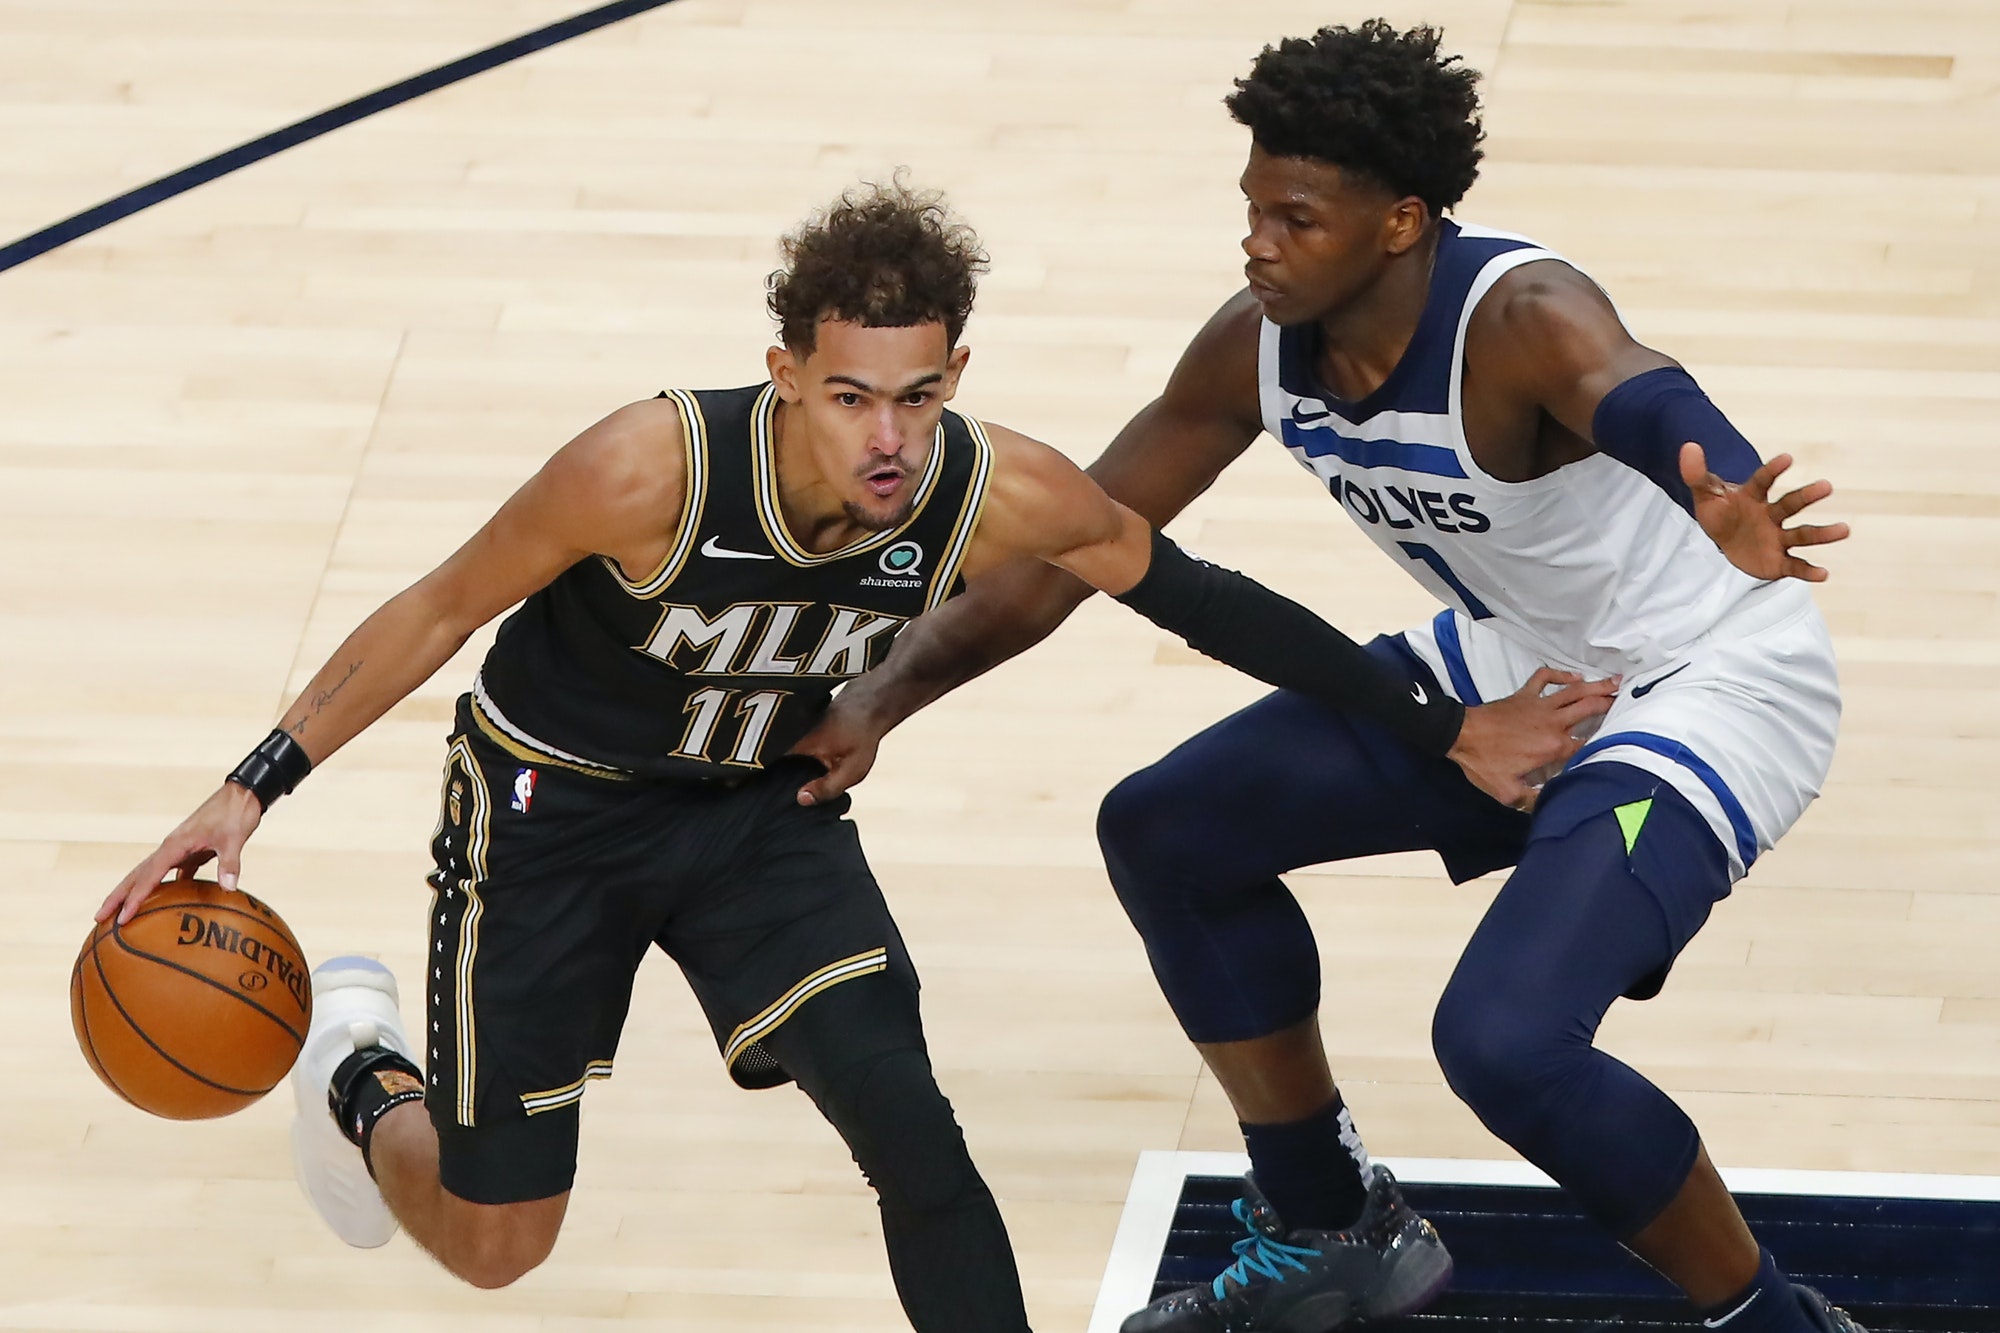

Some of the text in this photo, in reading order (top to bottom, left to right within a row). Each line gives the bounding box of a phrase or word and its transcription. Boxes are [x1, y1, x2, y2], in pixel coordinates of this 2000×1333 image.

[859, 576, 923, 588] sharecare
[1396, 541, 1497, 620] 1
[631, 602, 909, 677] MLK
[667, 686, 794, 769] 11
